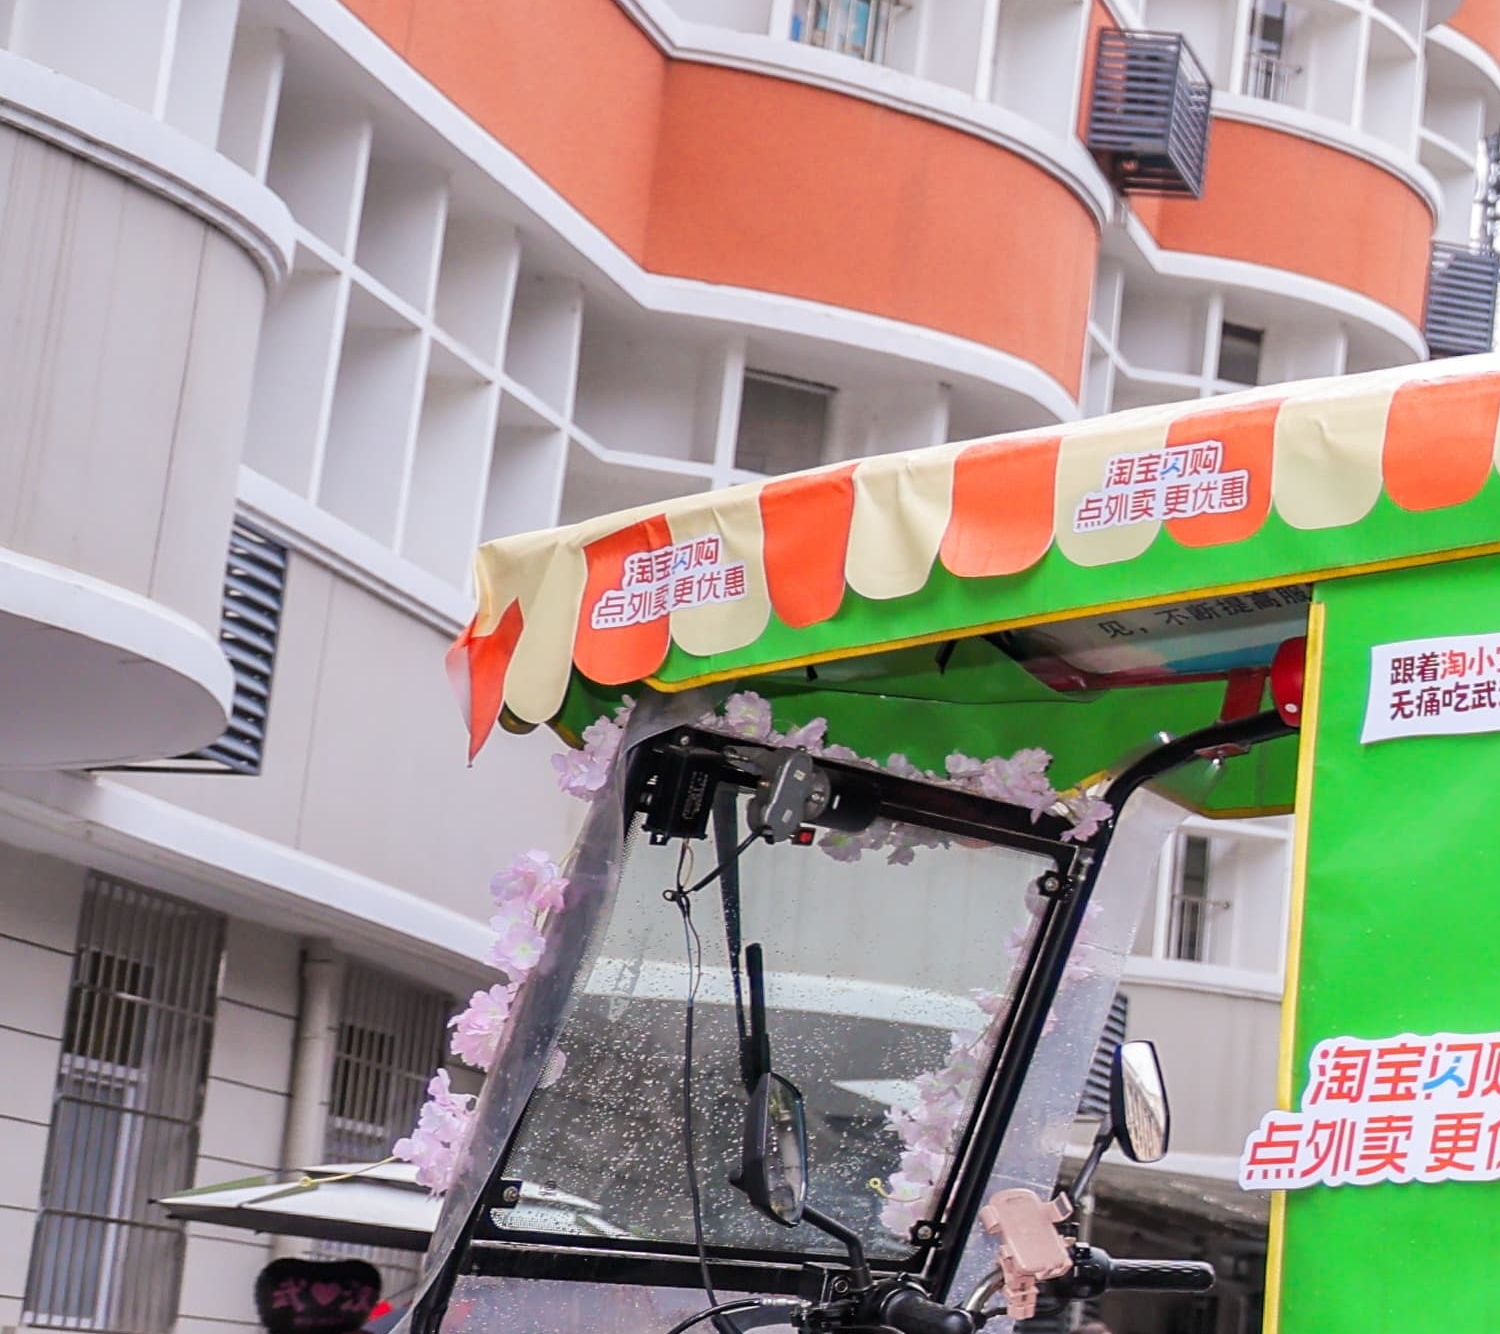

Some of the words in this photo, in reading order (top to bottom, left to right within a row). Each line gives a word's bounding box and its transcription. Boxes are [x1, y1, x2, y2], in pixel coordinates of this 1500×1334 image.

[1106, 445, 1219, 488] 淘宝闪购
[1076, 488, 1156, 529] 点外卖
[1162, 475, 1245, 516] 更优惠
[627, 537, 720, 586] 淘宝闪购
[595, 583, 670, 625] 点外卖
[672, 564, 745, 607] 更优惠
[1246, 1114, 1416, 1180] 点外卖
